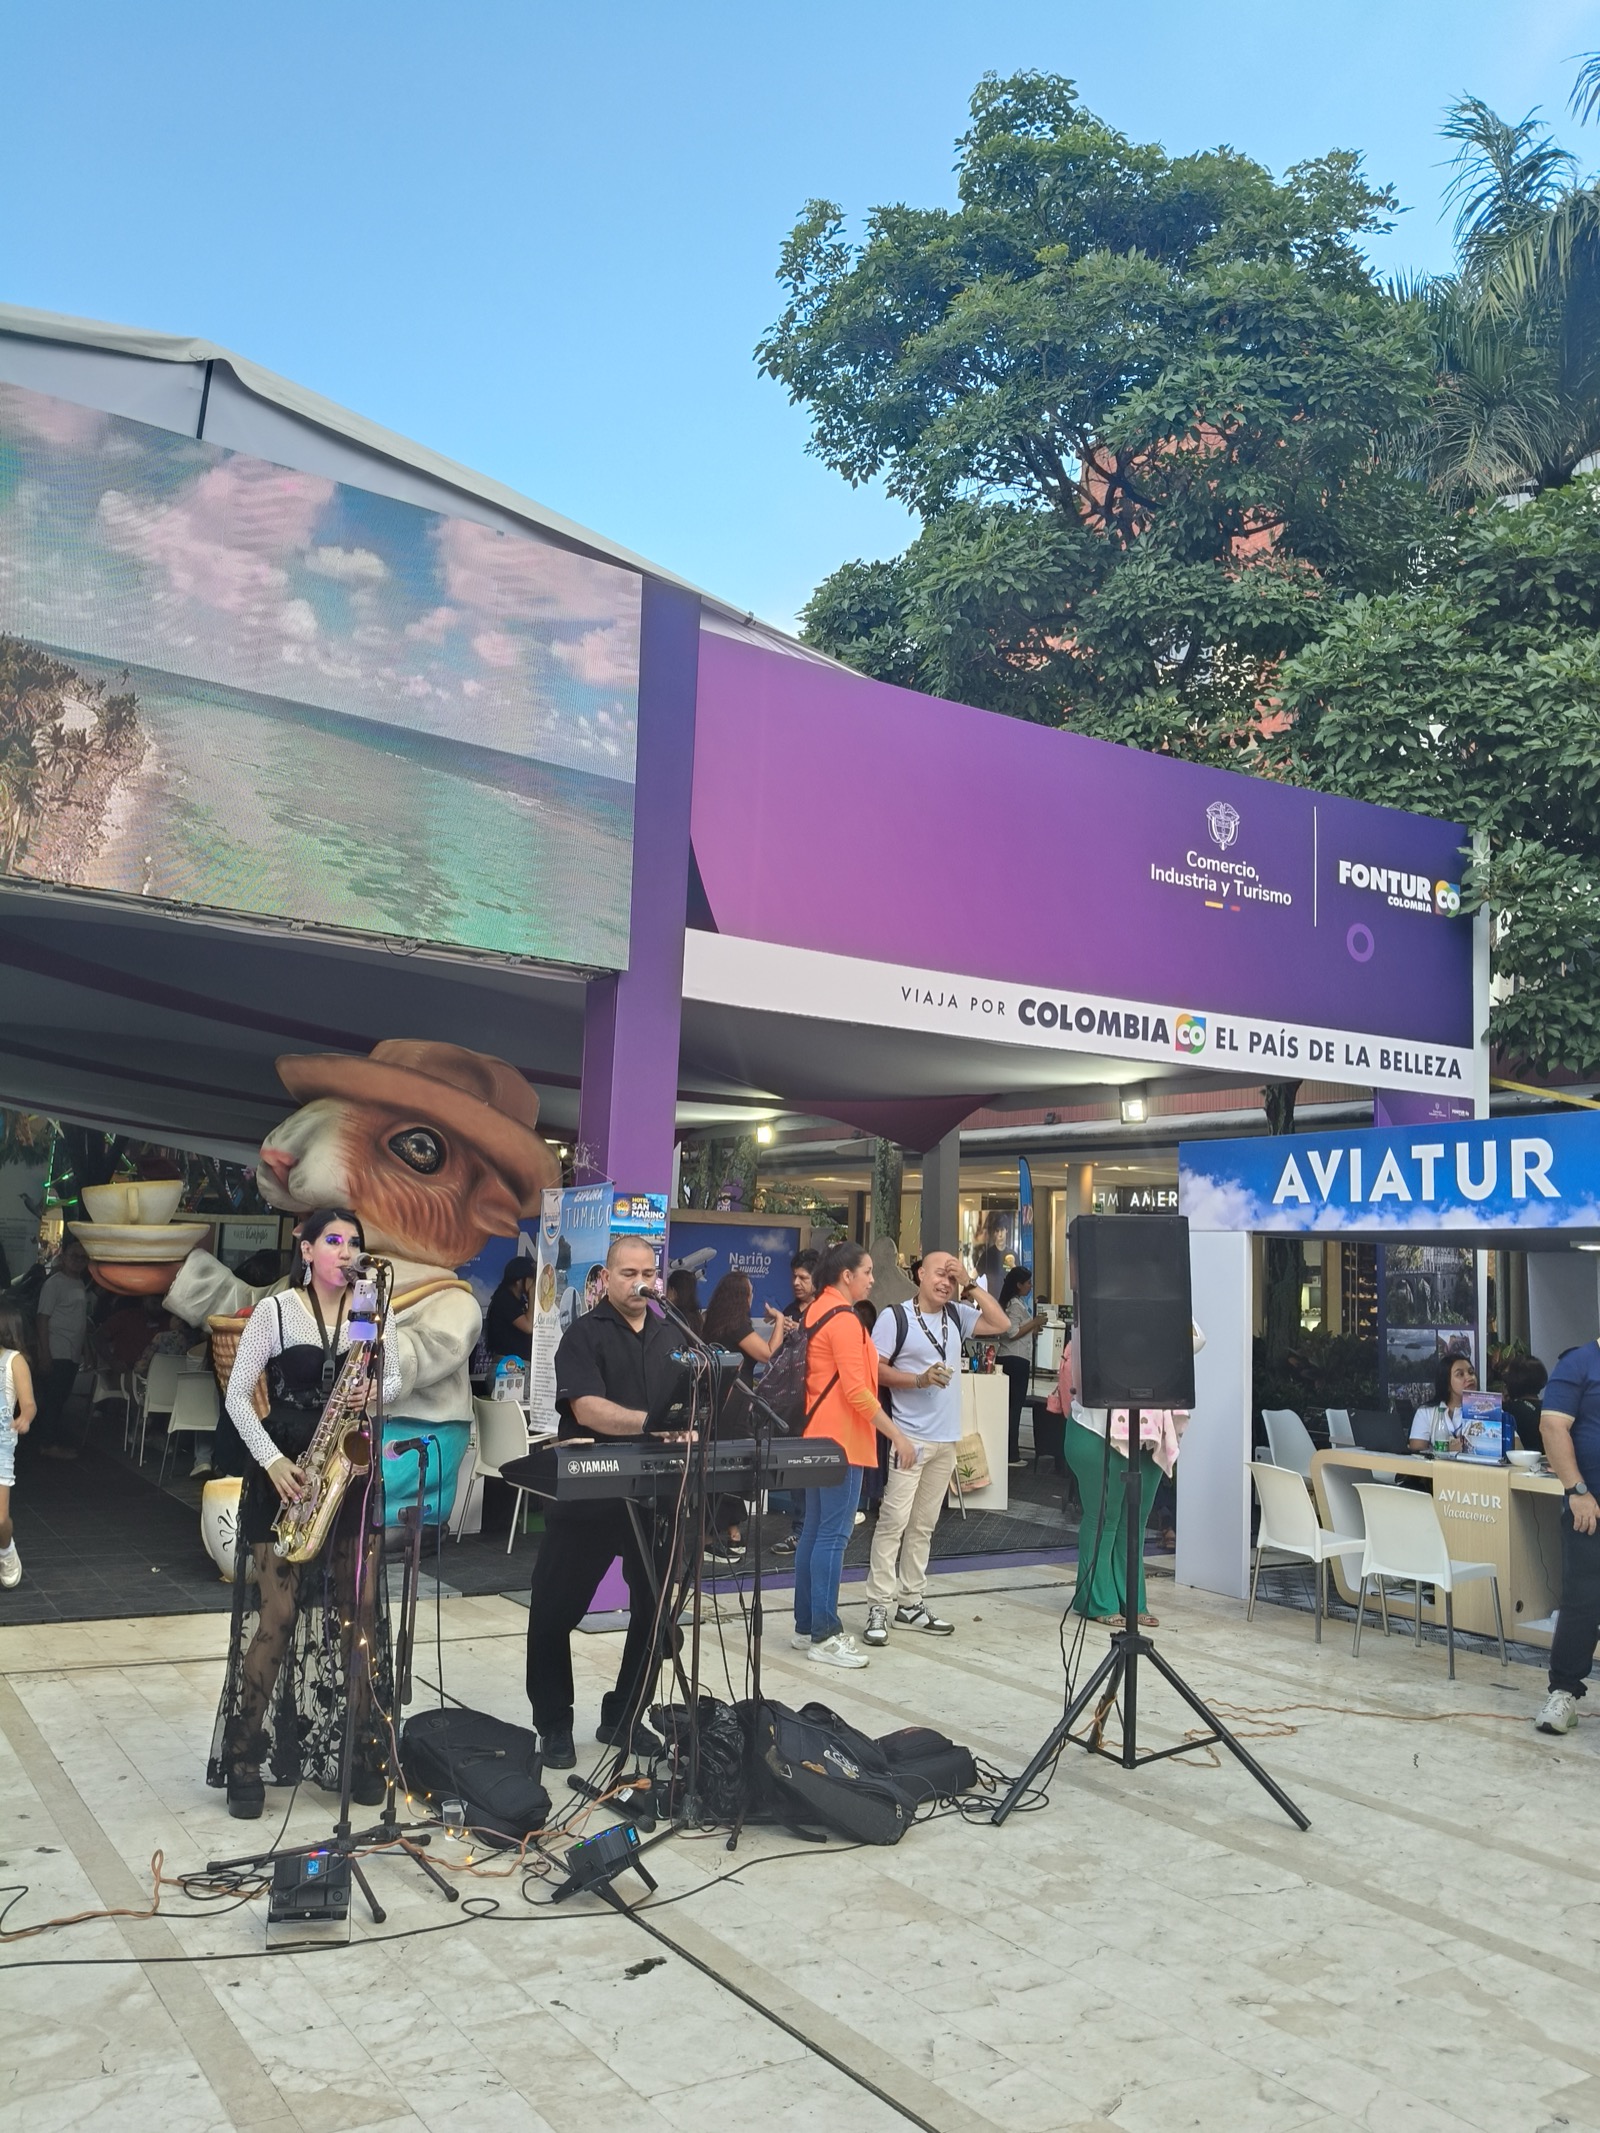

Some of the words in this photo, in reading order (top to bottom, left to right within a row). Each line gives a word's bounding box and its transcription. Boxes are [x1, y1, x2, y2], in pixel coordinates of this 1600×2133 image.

[1186, 851, 1259, 881] Comercio,
[1151, 863, 1217, 892] Industria
[1221, 881, 1230, 897] y
[1234, 879, 1292, 905] Turismo
[1339, 860, 1432, 901] FONTUR
[1387, 896, 1432, 913] COLOMBIA
[1436, 889, 1460, 911] CO
[901, 986, 958, 1008] VIAJA
[970, 997, 1005, 1015] POR
[1018, 998, 1170, 1044] COLOMBIA
[1177, 1023, 1206, 1046] CO
[1216, 1027, 1239, 1051] EL
[1249, 1028, 1298, 1058] PAÍS
[1309, 1039, 1335, 1063] DE
[1345, 1044, 1370, 1068] LA
[1380, 1048, 1462, 1079] BELLEZA
[1272, 1137, 1562, 1204] AVIATUR
[574, 1188, 603, 1203] EXPLORA
[565, 1203, 612, 1231] TUMACO
[631, 1210, 665, 1219] MARINO
[729, 1252, 772, 1265] Nariño
[580, 1460, 619, 1473] YAMAHA
[1438, 1489, 1502, 1509] AVIATUR
[1443, 1503, 1496, 1524] Vacaciones
